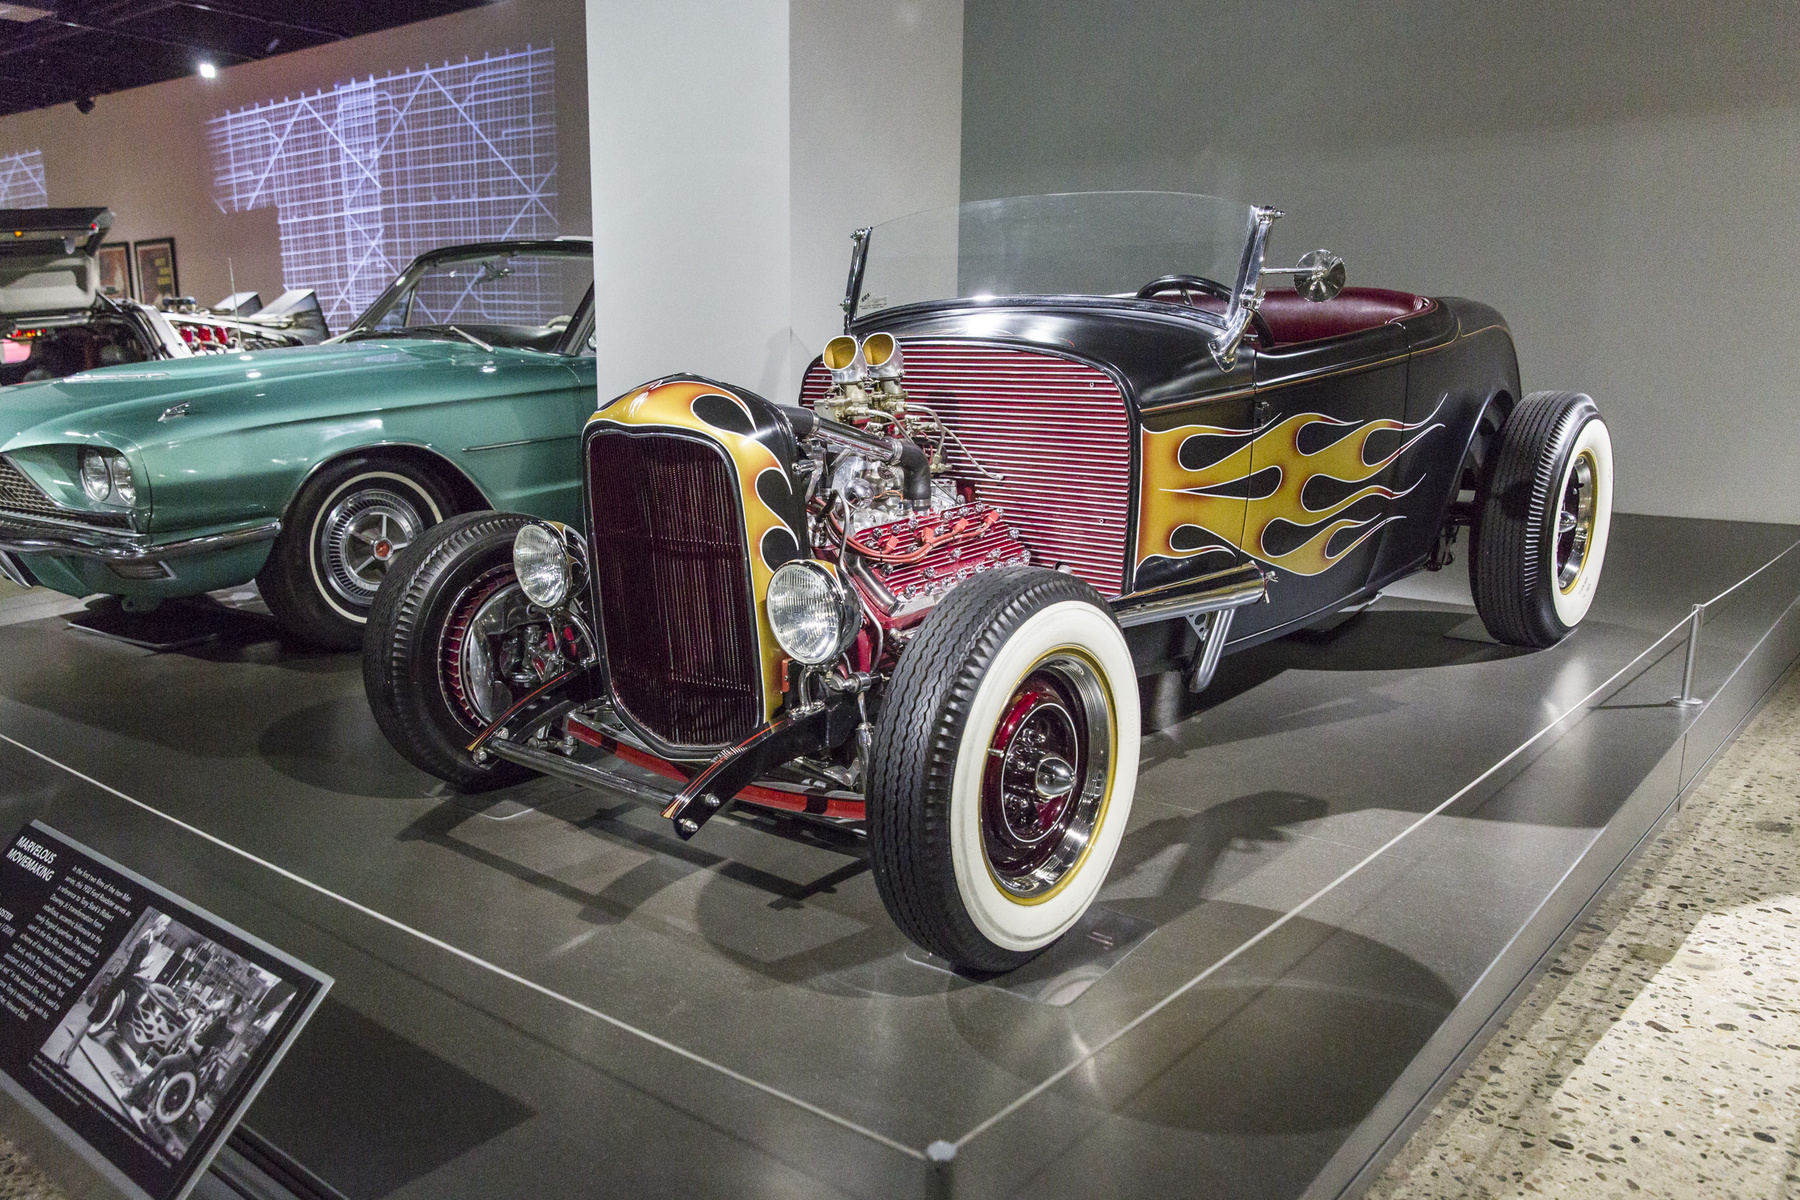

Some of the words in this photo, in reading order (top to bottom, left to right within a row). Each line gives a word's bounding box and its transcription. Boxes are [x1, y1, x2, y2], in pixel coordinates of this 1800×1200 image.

[16, 836, 57, 864] MARVELOUS
[6, 848, 55, 882] MOVIEMAKING
[0, 907, 14, 921] DSTER
